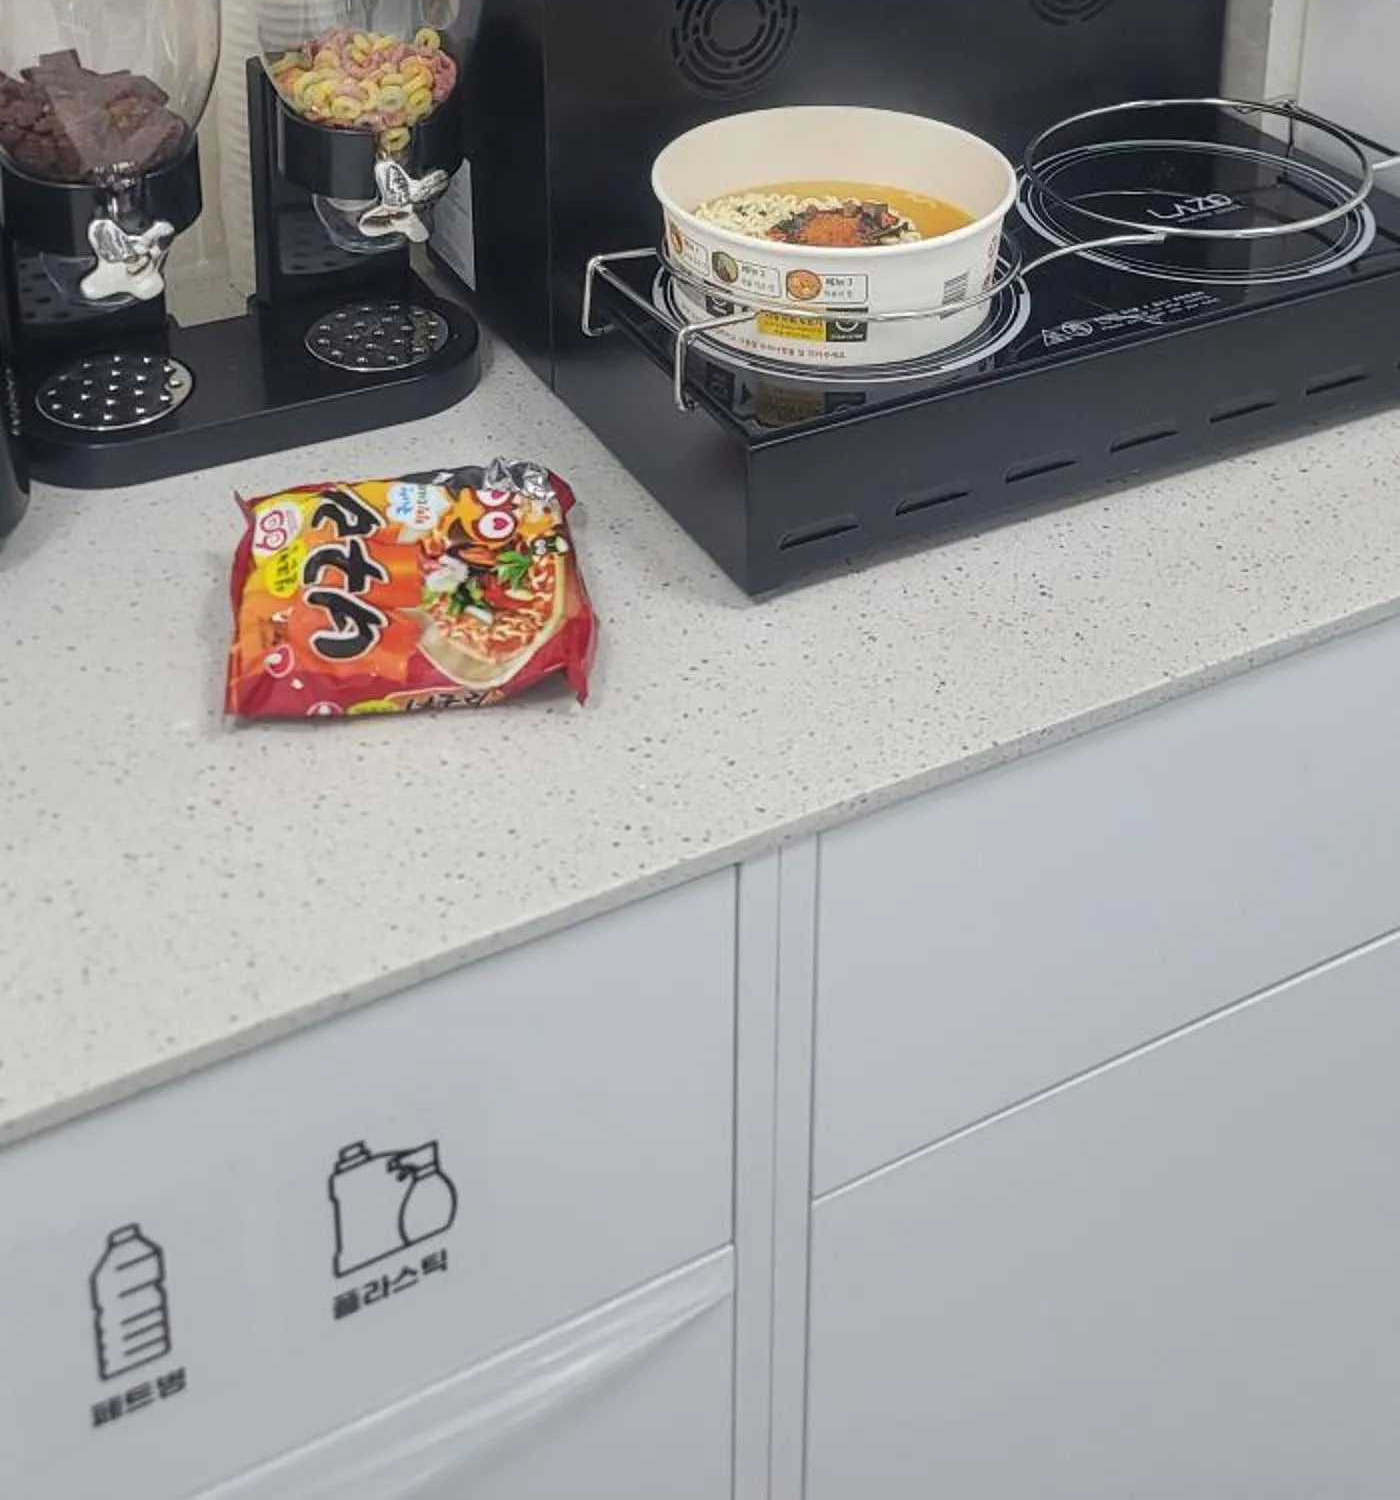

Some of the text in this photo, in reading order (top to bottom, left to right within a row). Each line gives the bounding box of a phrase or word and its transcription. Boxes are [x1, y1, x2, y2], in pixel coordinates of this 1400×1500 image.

[1146, 193, 1232, 219] LAZO
[303, 489, 389, 659] 너구리
[333, 1249, 448, 1320] 플라스틱
[91, 1367, 187, 1428] 페트병
